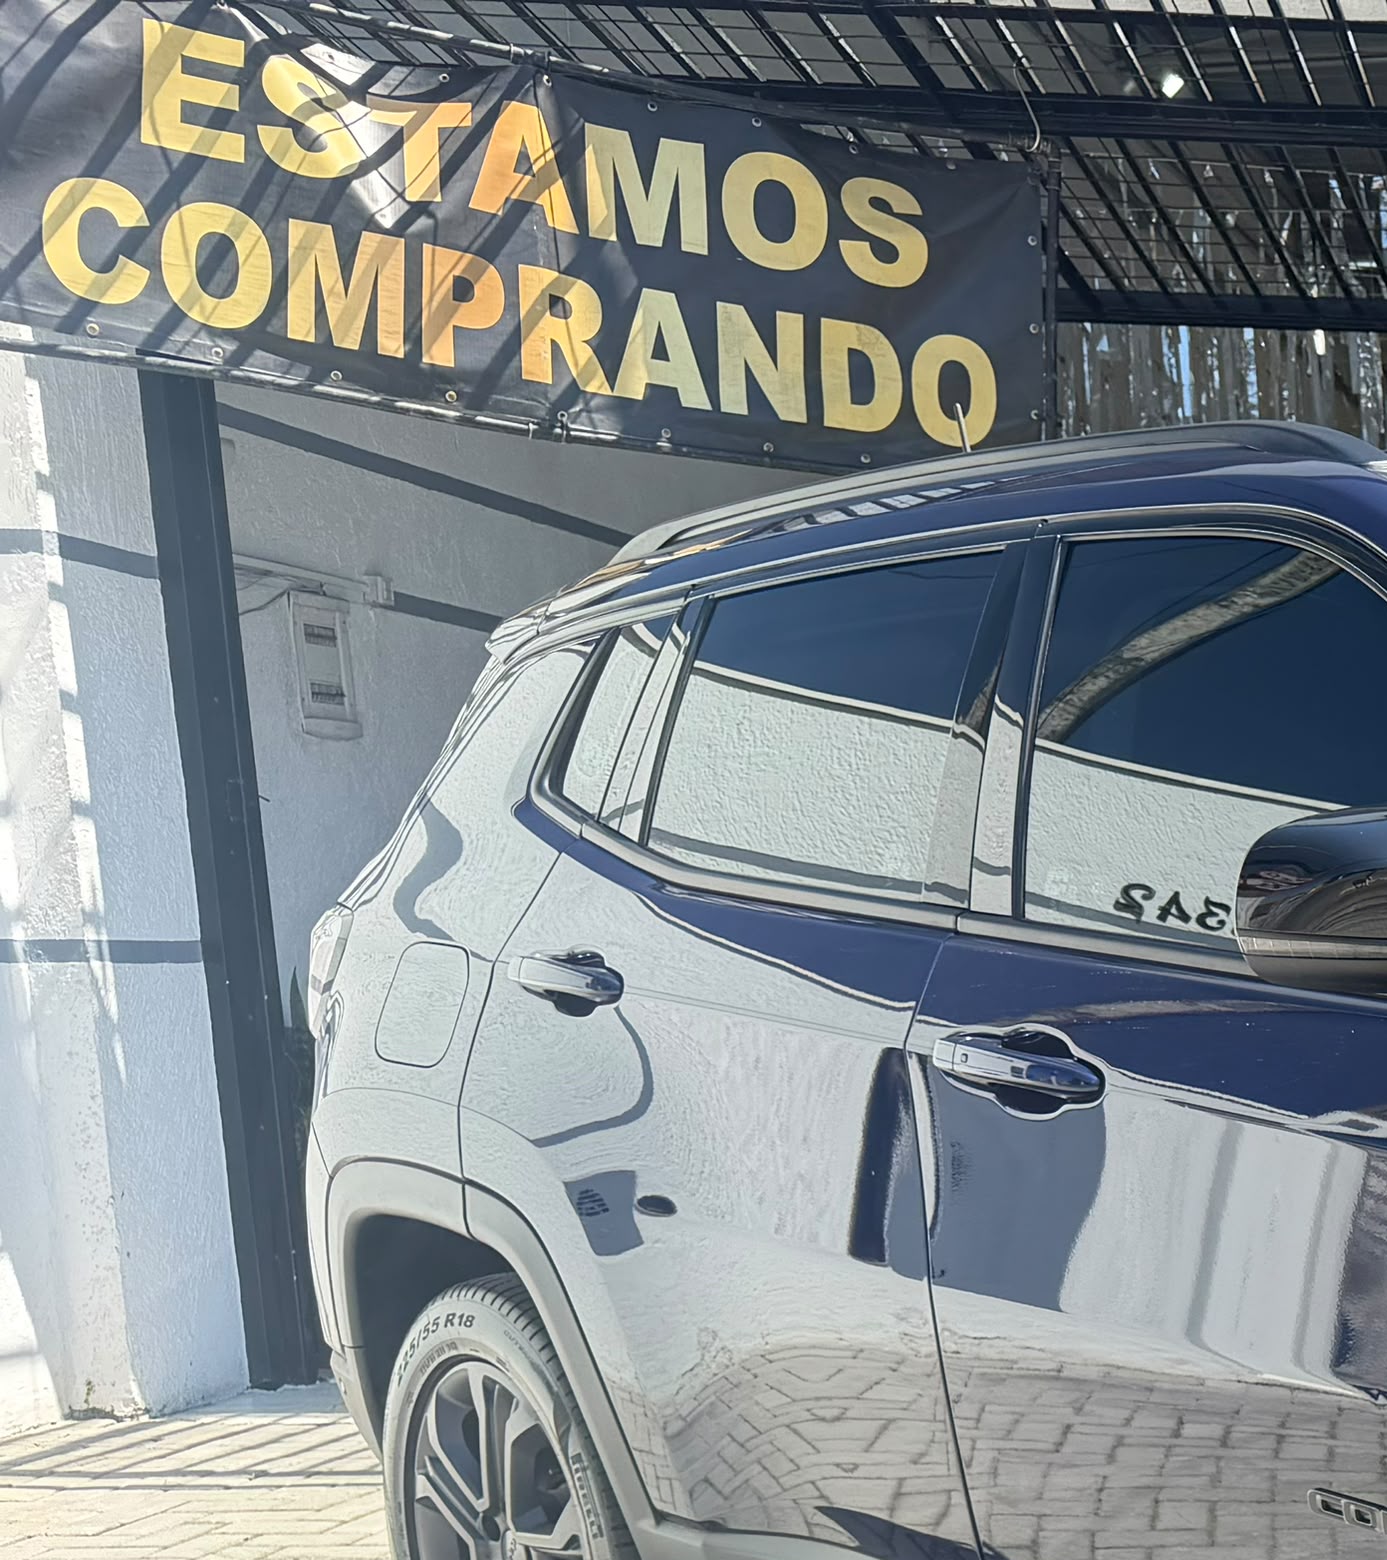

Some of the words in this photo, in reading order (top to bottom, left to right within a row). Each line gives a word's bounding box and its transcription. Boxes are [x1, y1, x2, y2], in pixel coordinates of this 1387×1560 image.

[140, 18, 930, 289] ESTAMOS
[41, 176, 998, 449] COMPRANDO
[444, 1312, 475, 1329] R18
